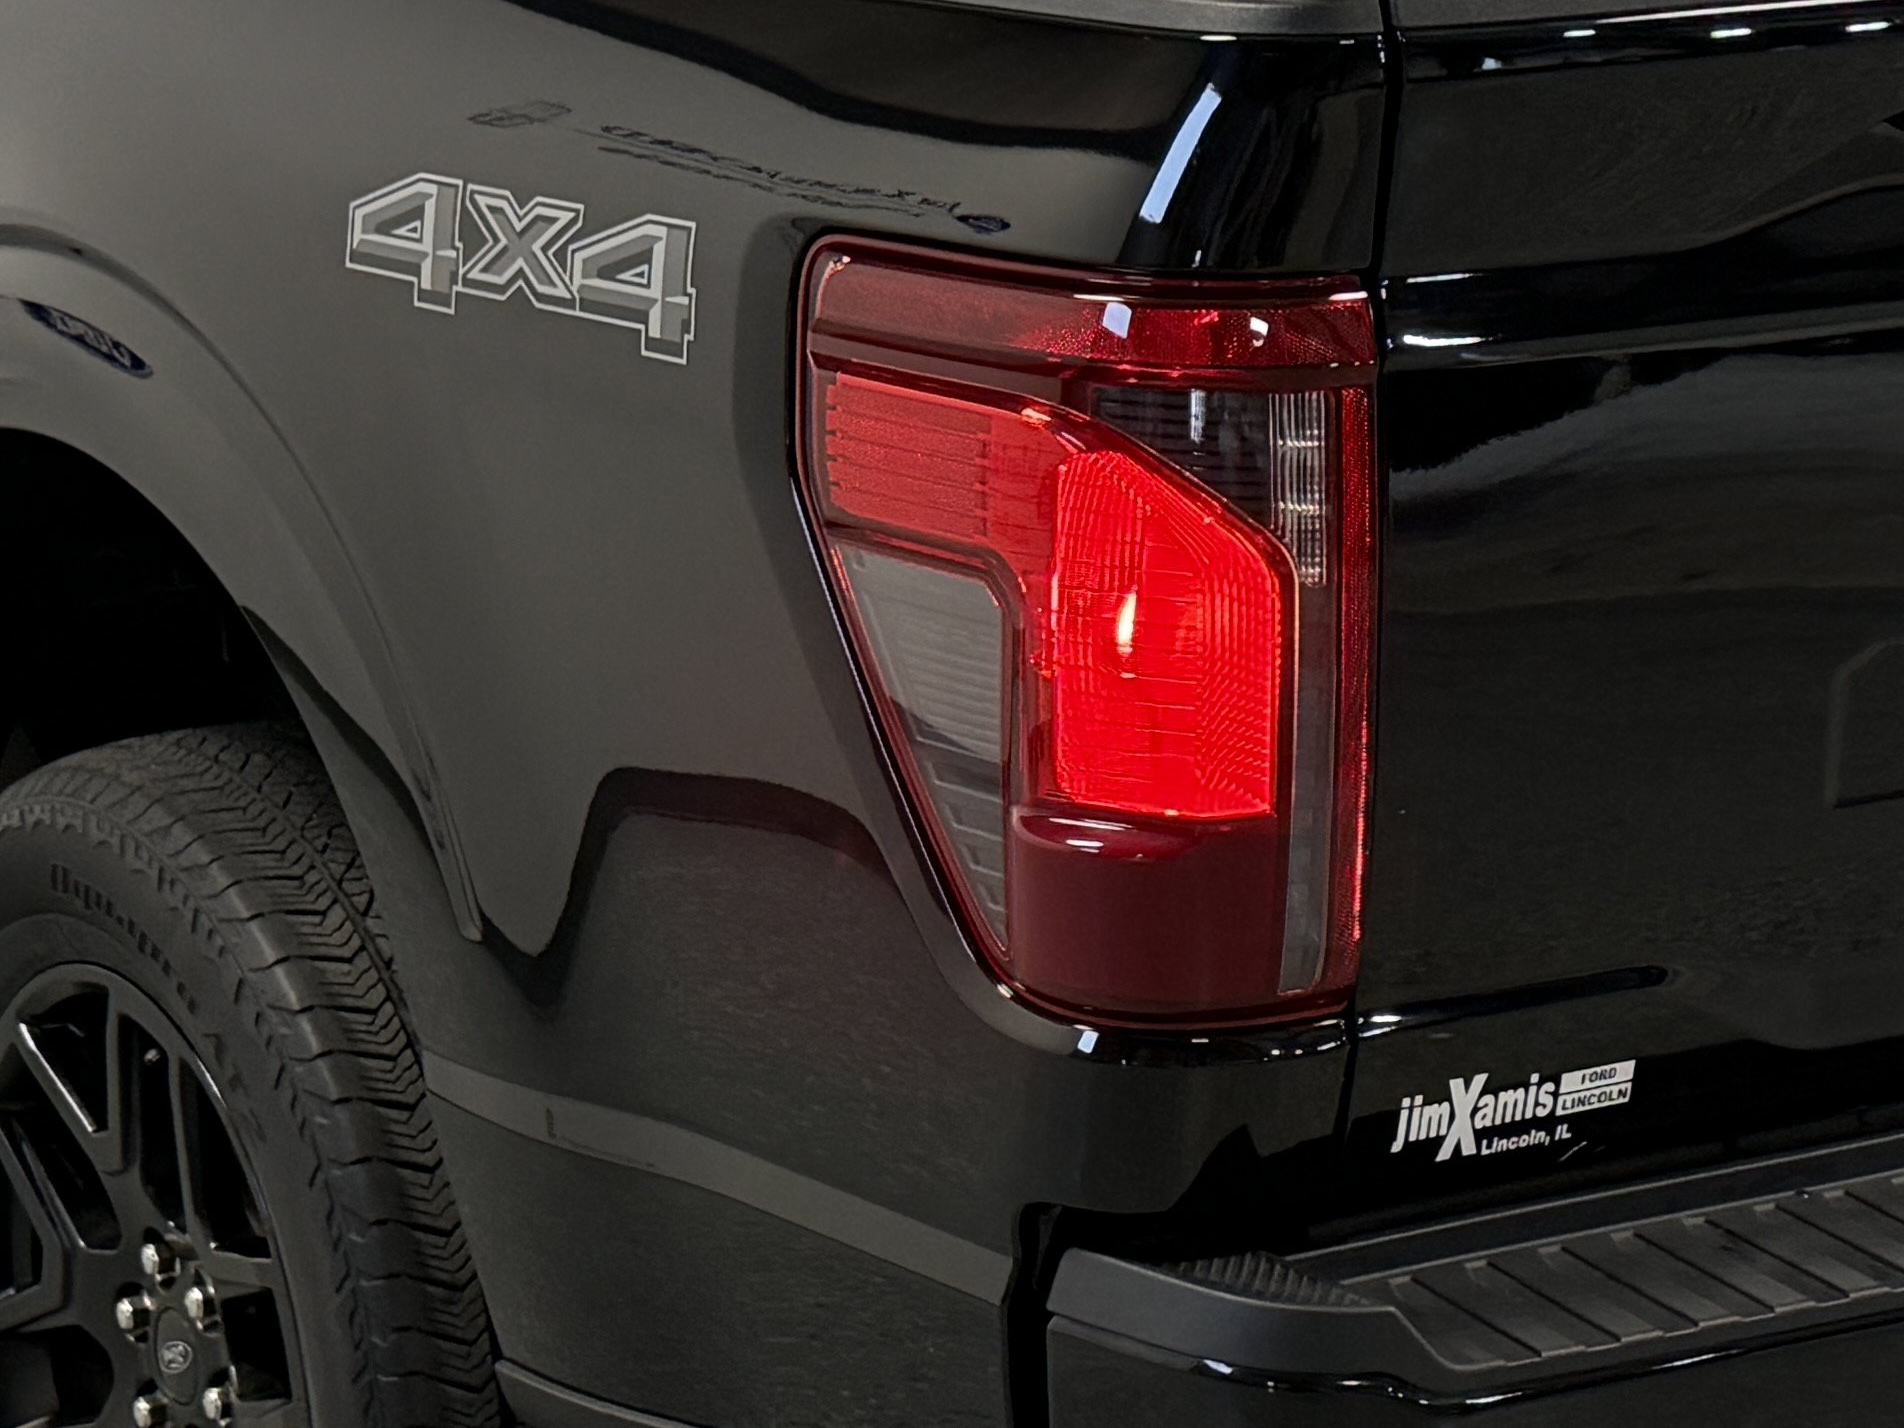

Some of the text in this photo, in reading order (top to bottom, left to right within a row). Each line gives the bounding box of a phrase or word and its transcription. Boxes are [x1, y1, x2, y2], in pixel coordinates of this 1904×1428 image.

[1581, 1066, 1618, 1086] FORD
[1561, 1086, 1629, 1112] LINCOLN
[1481, 1123, 1572, 1156] Lincoln, IL
